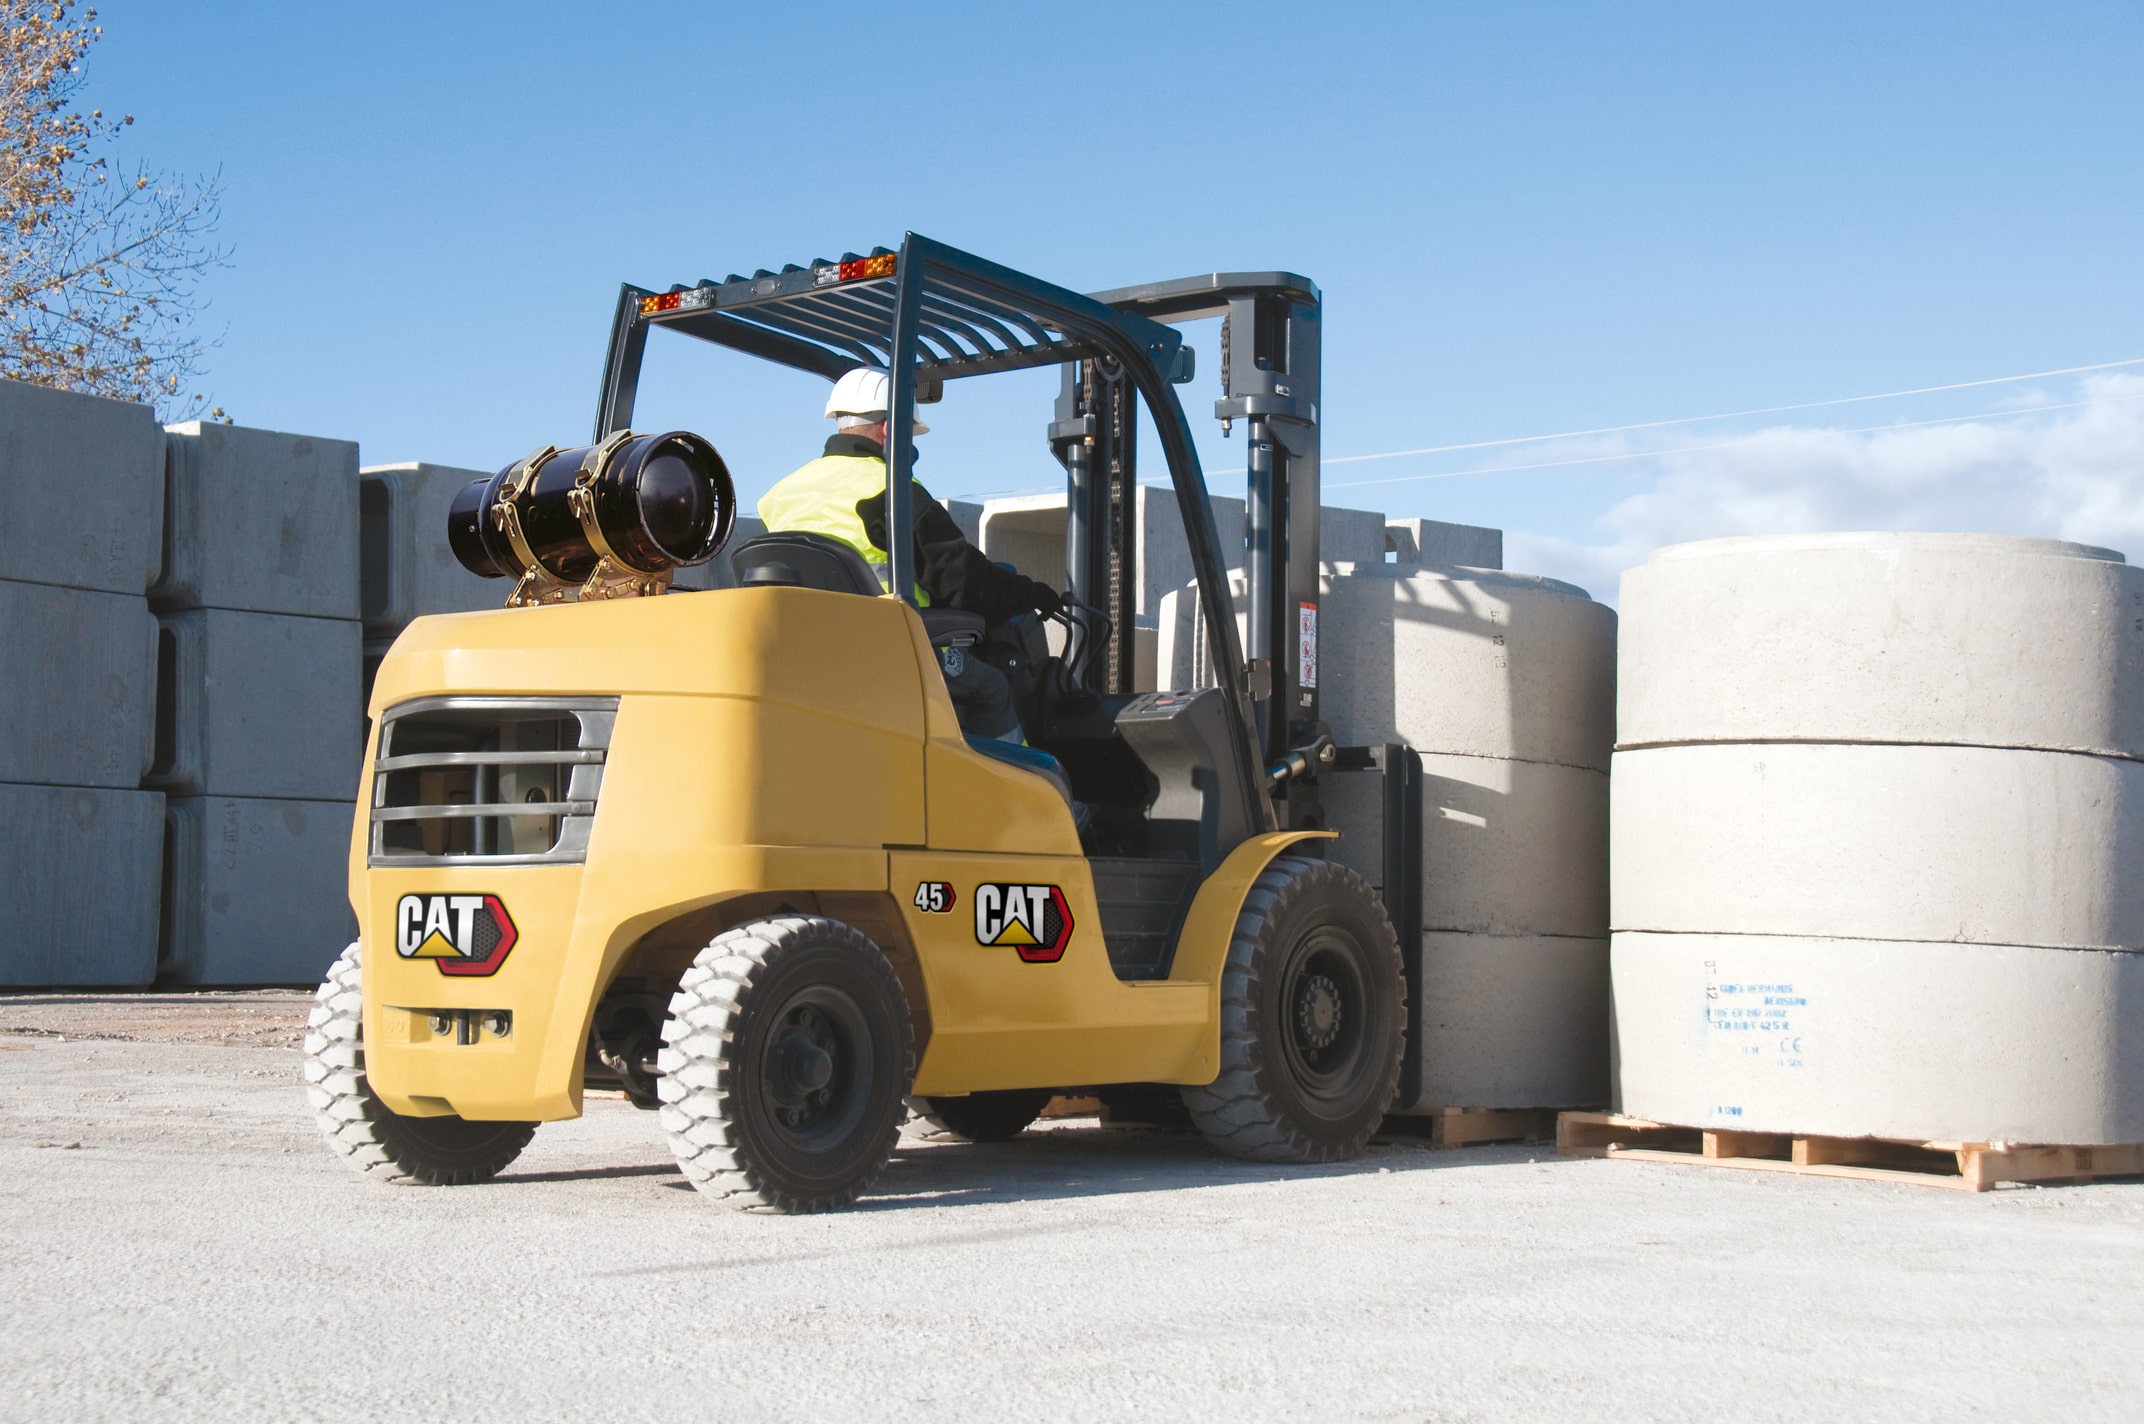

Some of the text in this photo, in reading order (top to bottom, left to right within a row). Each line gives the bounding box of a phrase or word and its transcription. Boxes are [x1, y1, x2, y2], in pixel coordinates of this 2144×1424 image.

[397, 894, 484, 958] CAT
[914, 882, 944, 912] 45
[975, 883, 1051, 945] CAT
